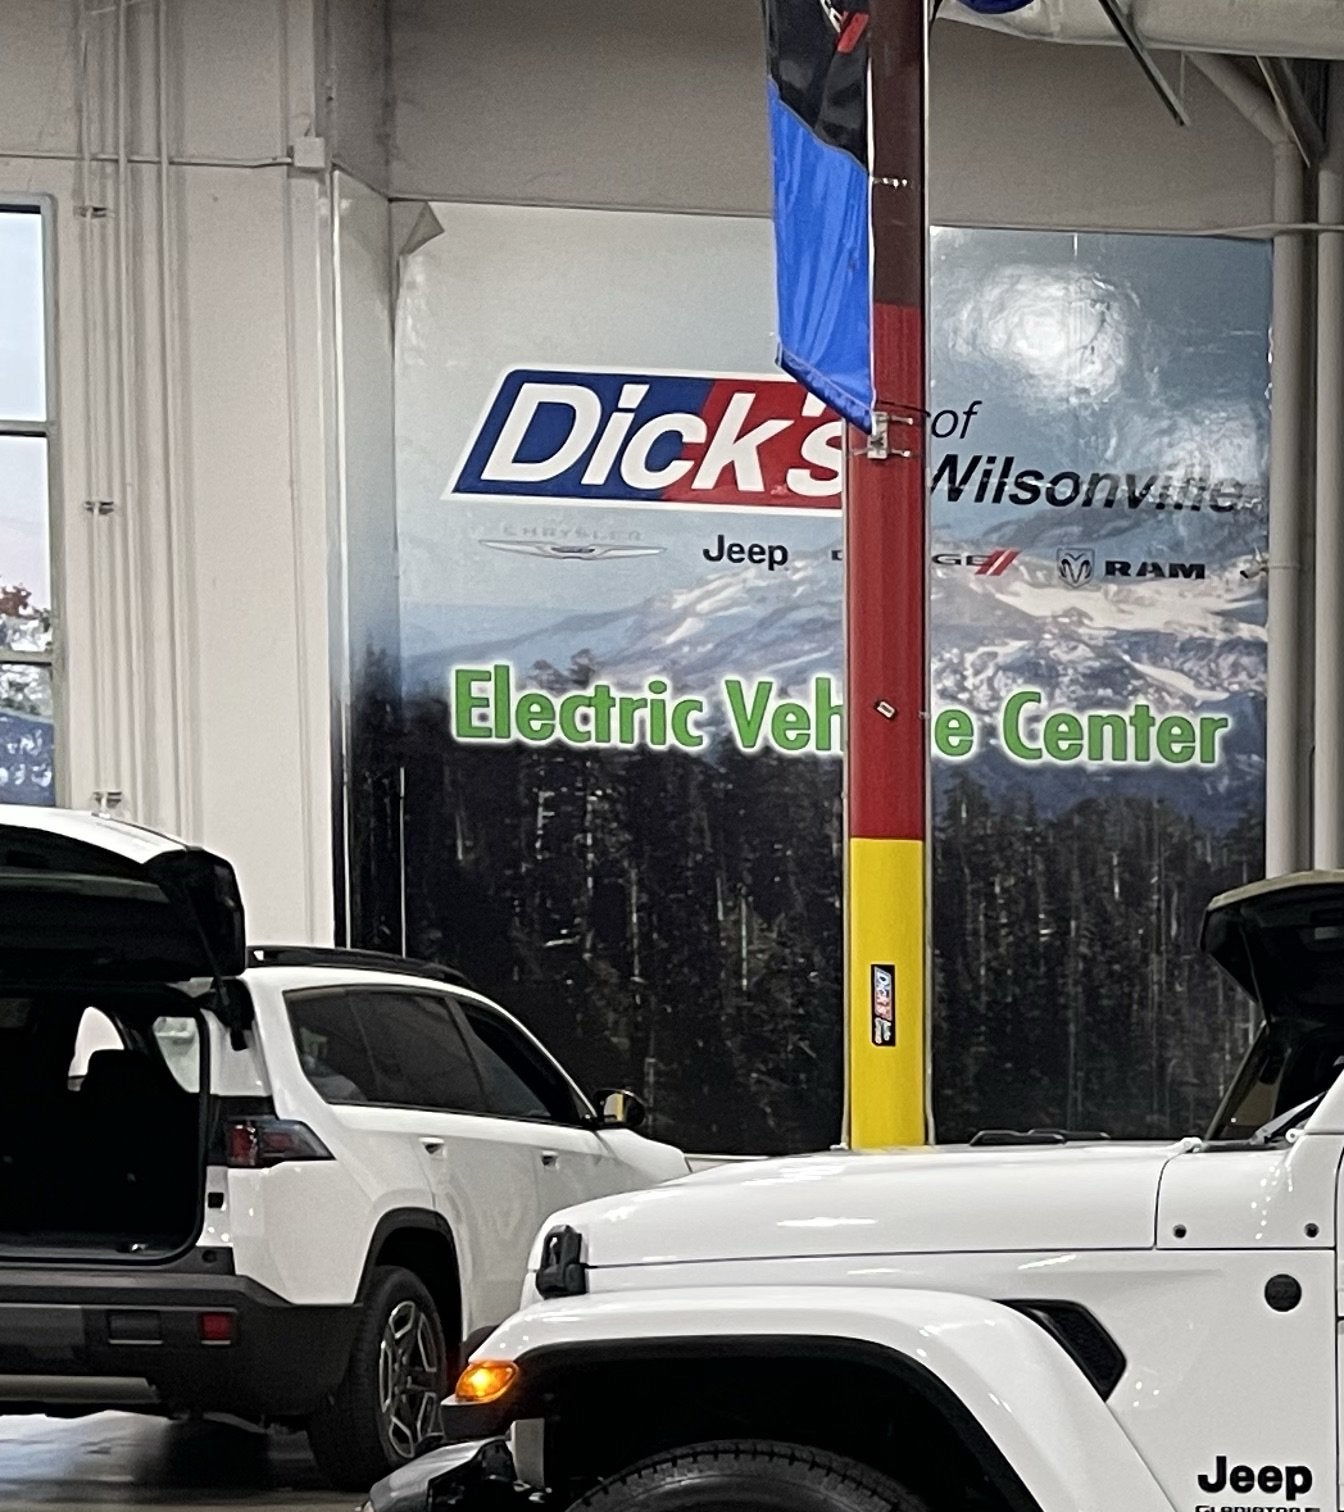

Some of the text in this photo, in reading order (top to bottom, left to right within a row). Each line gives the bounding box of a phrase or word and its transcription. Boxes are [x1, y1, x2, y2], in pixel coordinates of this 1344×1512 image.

[480, 382, 842, 497] Dick's
[931, 400, 983, 440] of
[702, 534, 789, 571] Jeep
[1104, 559, 1206, 580] RAM
[455, 663, 1229, 764] Electric Vehe Center
[1197, 1455, 1313, 1501] Jeep
